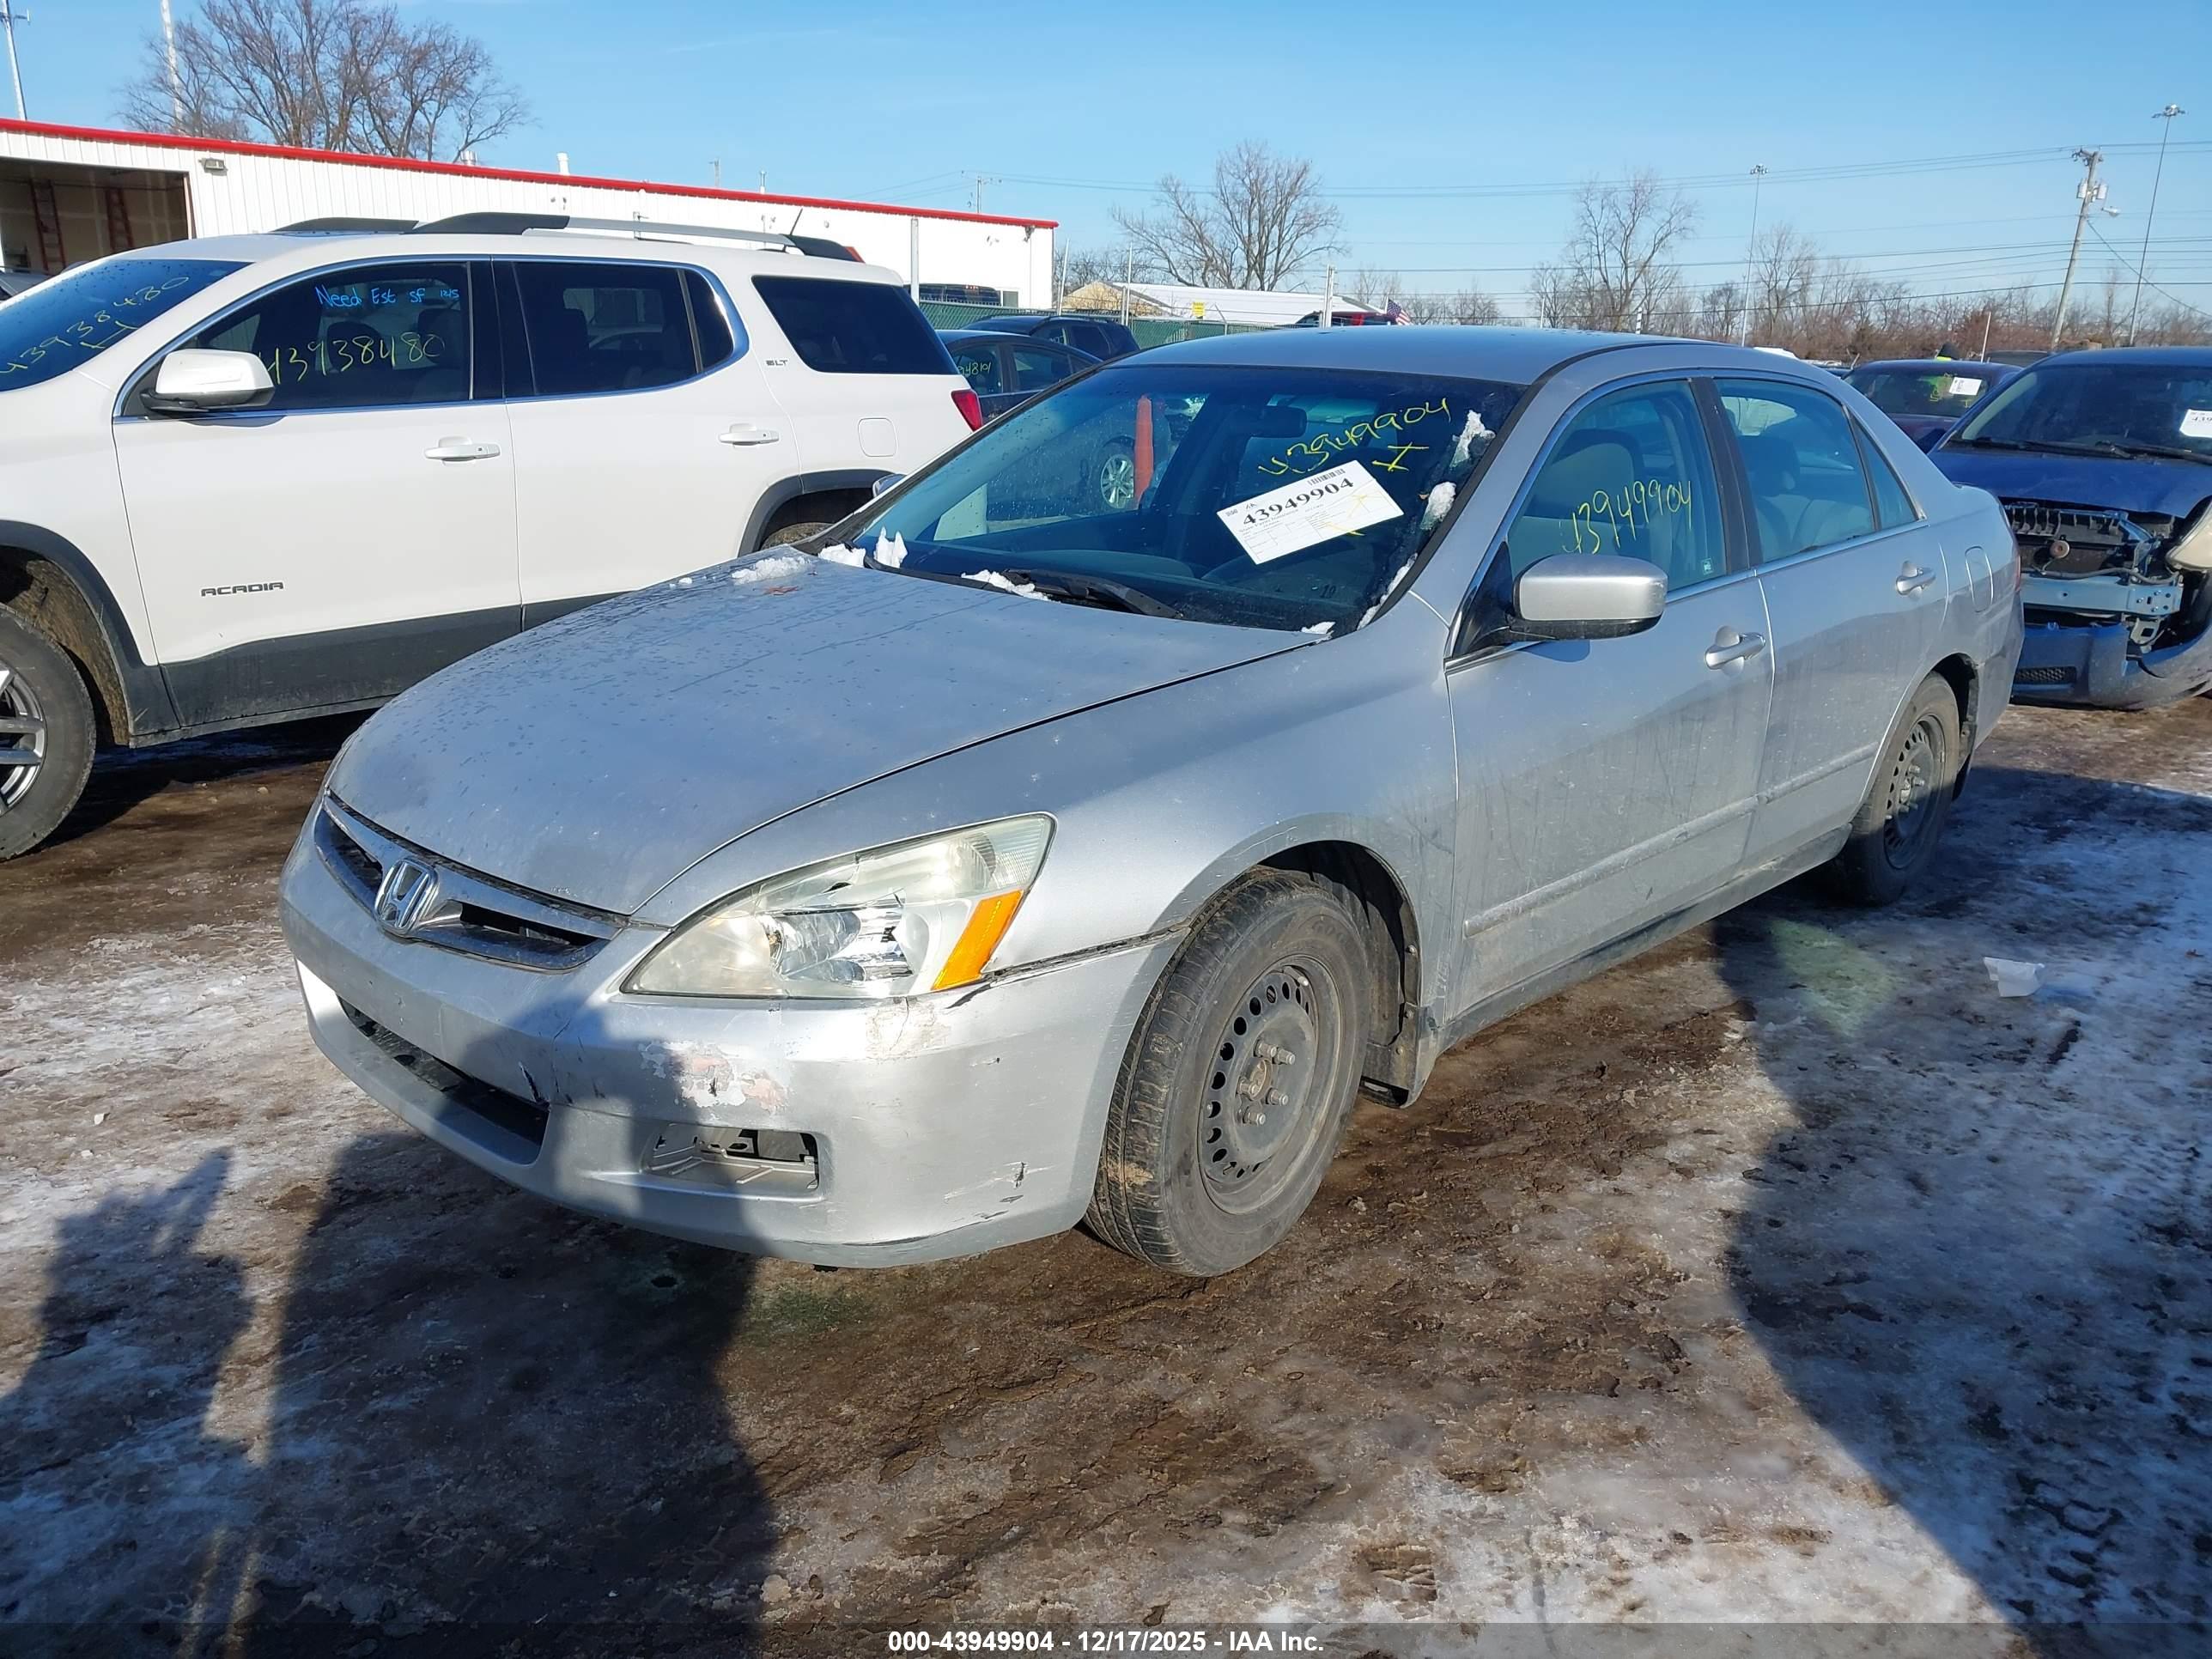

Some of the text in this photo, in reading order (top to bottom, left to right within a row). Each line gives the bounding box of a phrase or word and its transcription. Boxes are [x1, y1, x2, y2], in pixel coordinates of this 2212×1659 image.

[314, 284, 362, 307] Need
[1257, 398, 1452, 475] 43949904
[1243, 477, 1354, 527] 43949904
[201, 581, 284, 597] ACADIA
